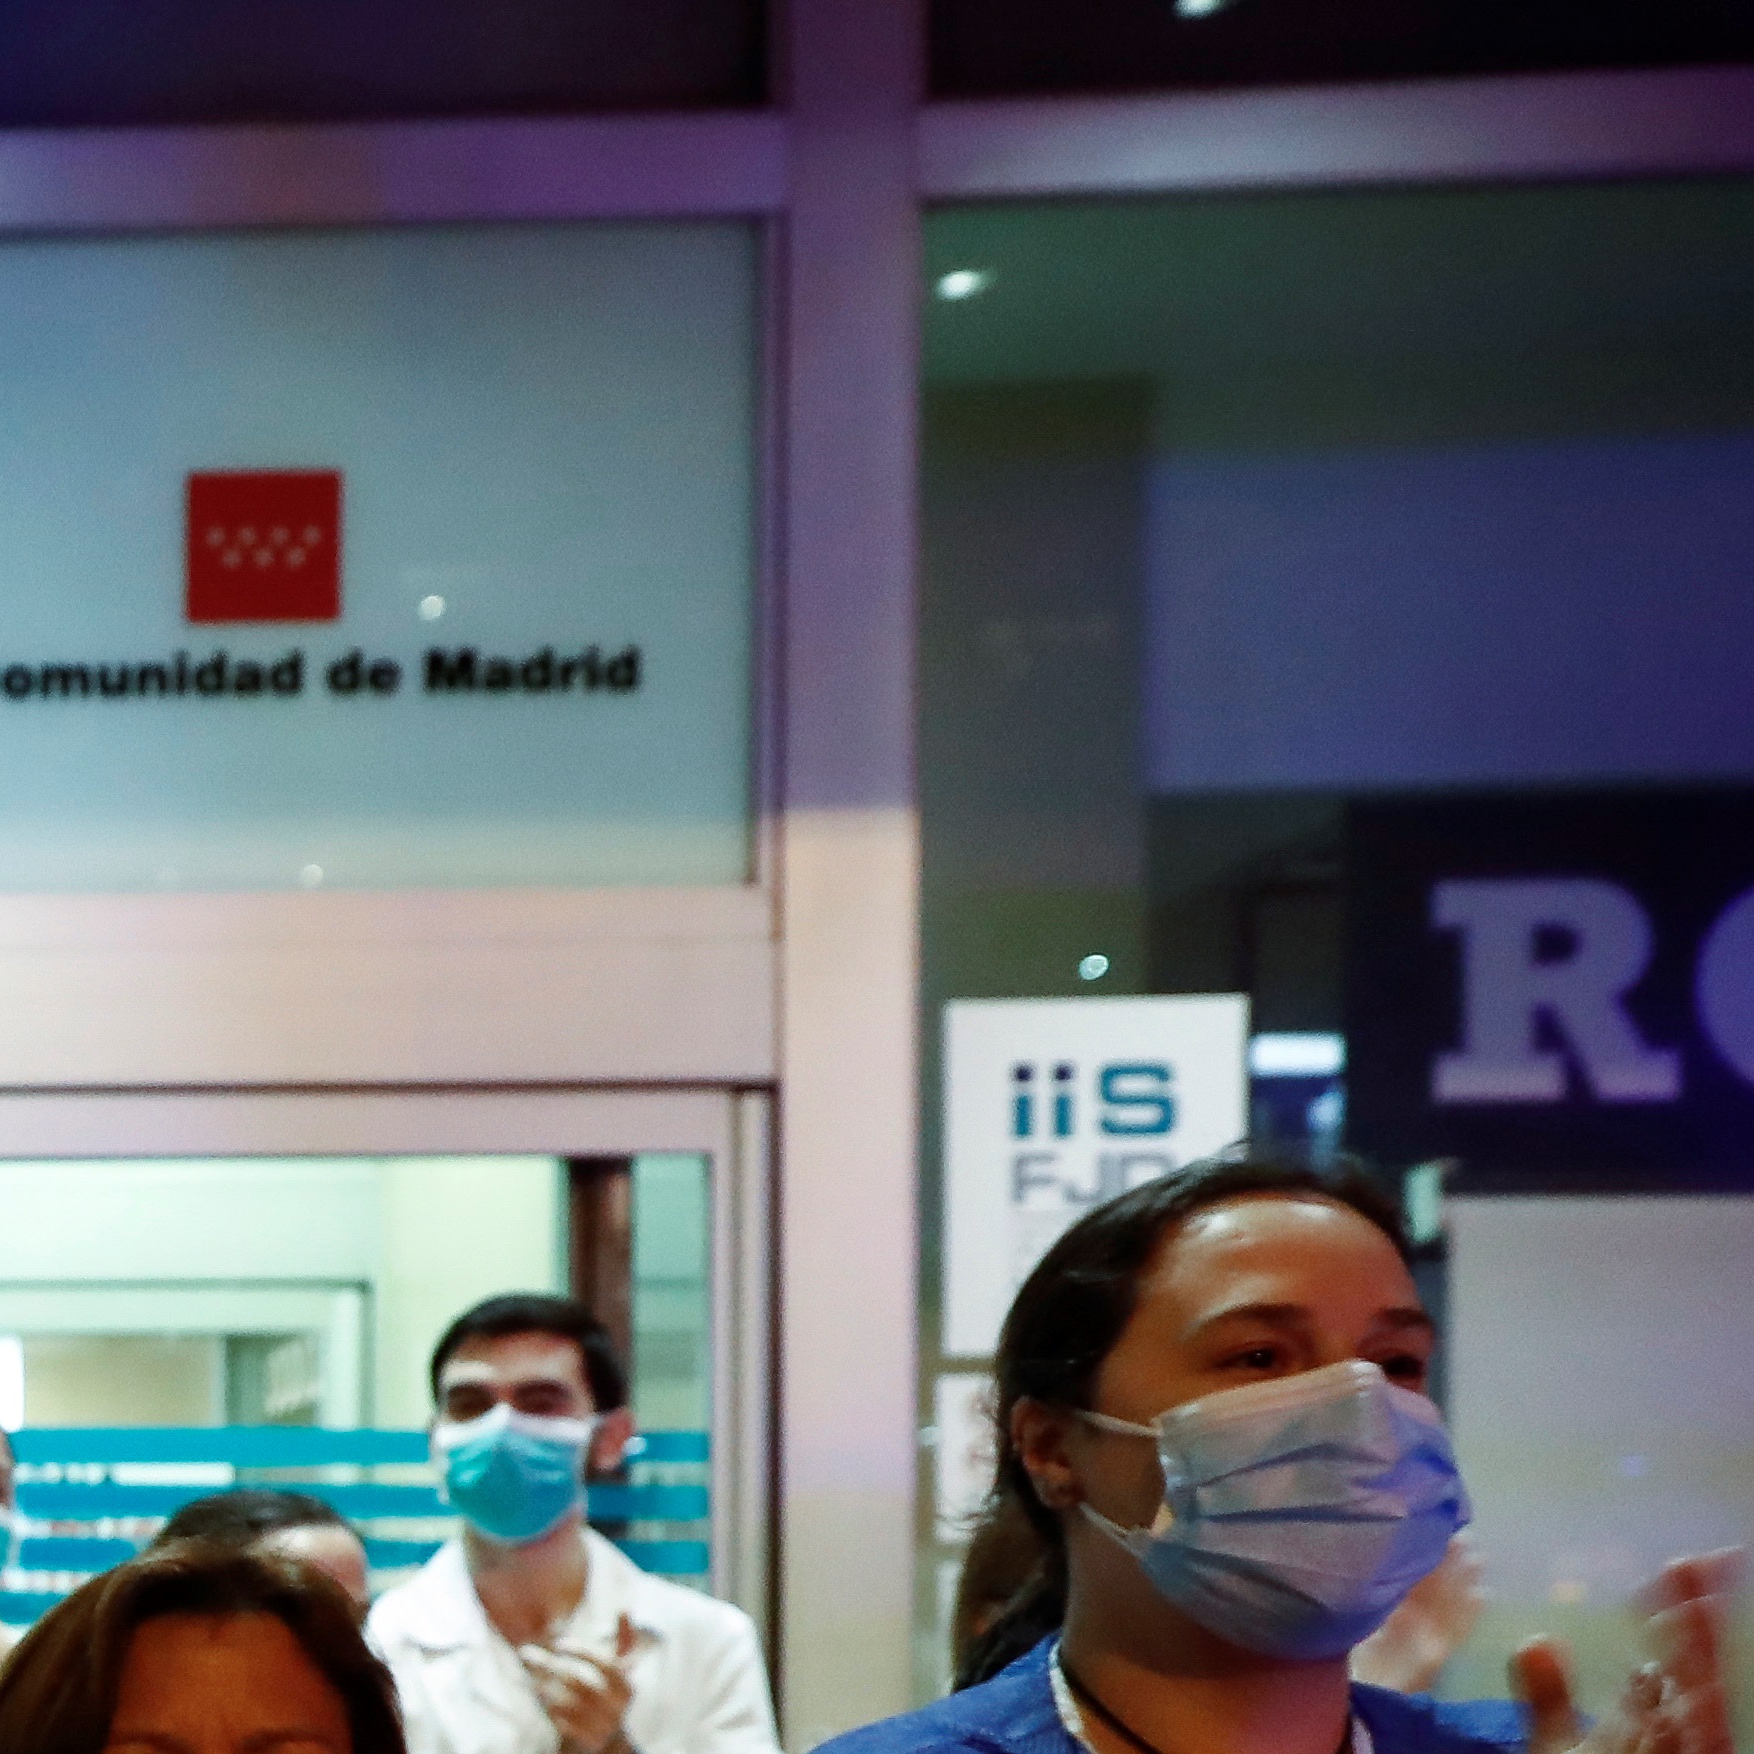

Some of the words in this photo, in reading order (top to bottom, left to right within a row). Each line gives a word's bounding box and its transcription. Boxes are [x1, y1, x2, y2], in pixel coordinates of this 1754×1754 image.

[326, 648, 400, 695] de
[423, 645, 641, 693] Madrid
[1430, 878, 1754, 1104] R
